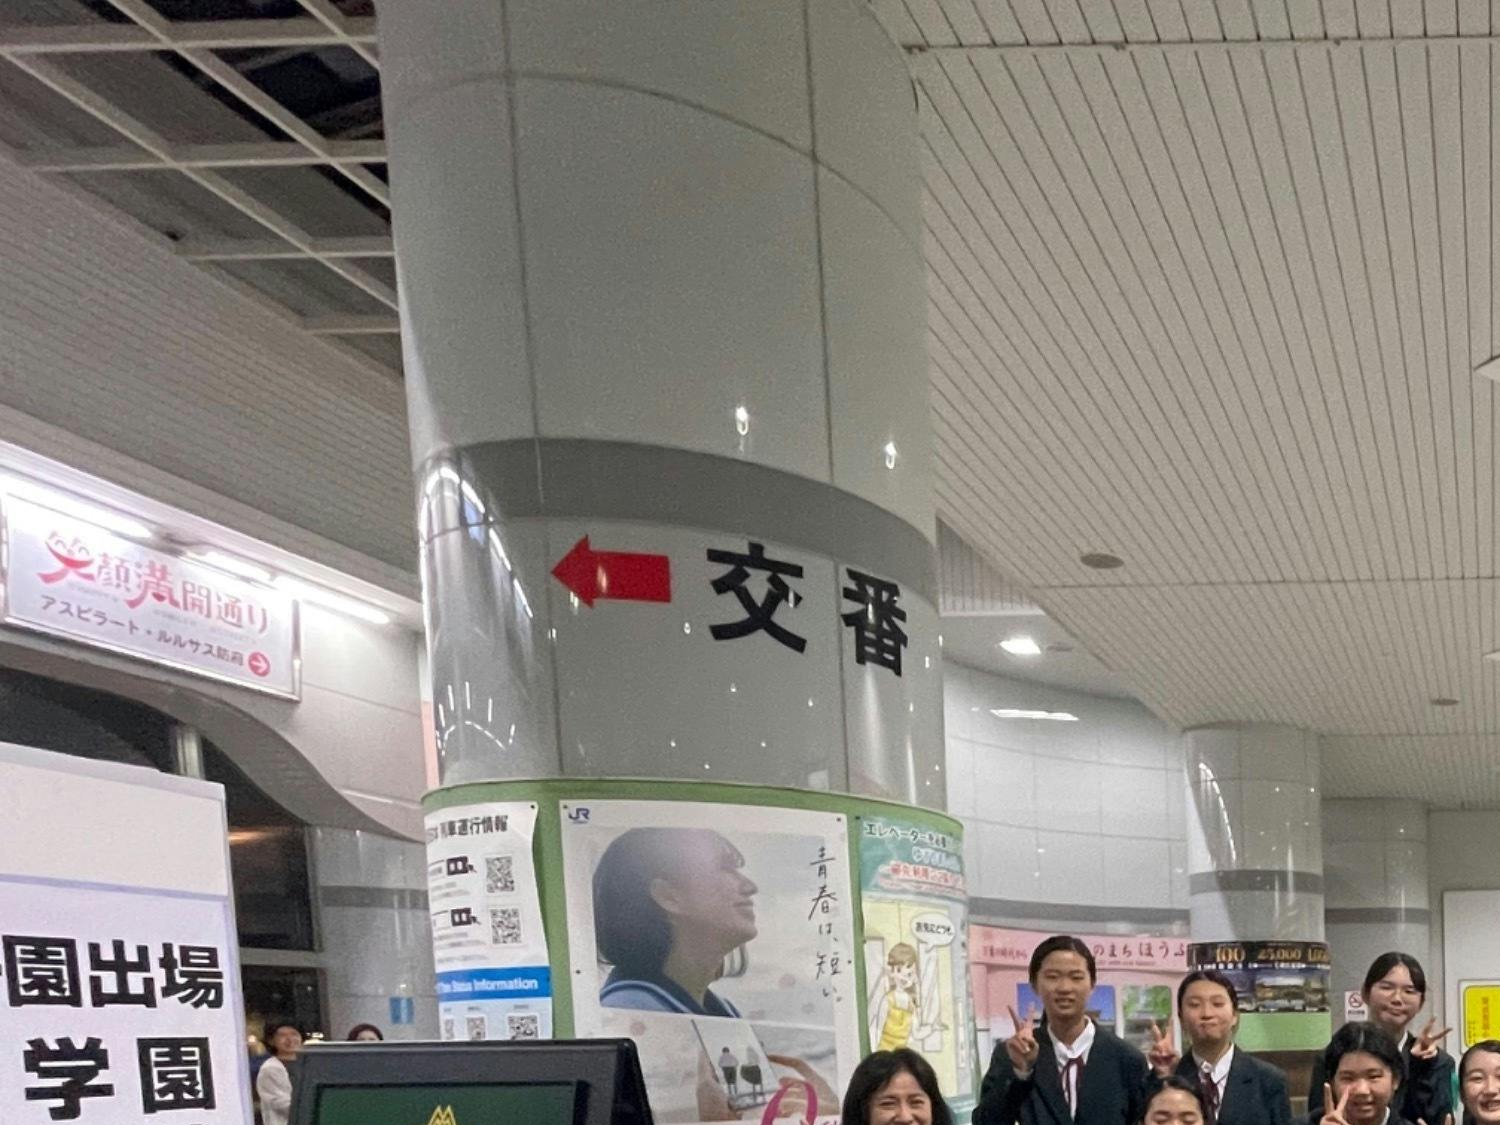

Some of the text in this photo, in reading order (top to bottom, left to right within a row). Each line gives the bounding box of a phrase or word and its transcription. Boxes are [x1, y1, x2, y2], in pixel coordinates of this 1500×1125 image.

[37, 531, 268, 634] 笑顔満開通り
[707, 541, 908, 677] 交番
[568, 807, 590, 820] JR
[0, 935, 225, 1010] 園出場
